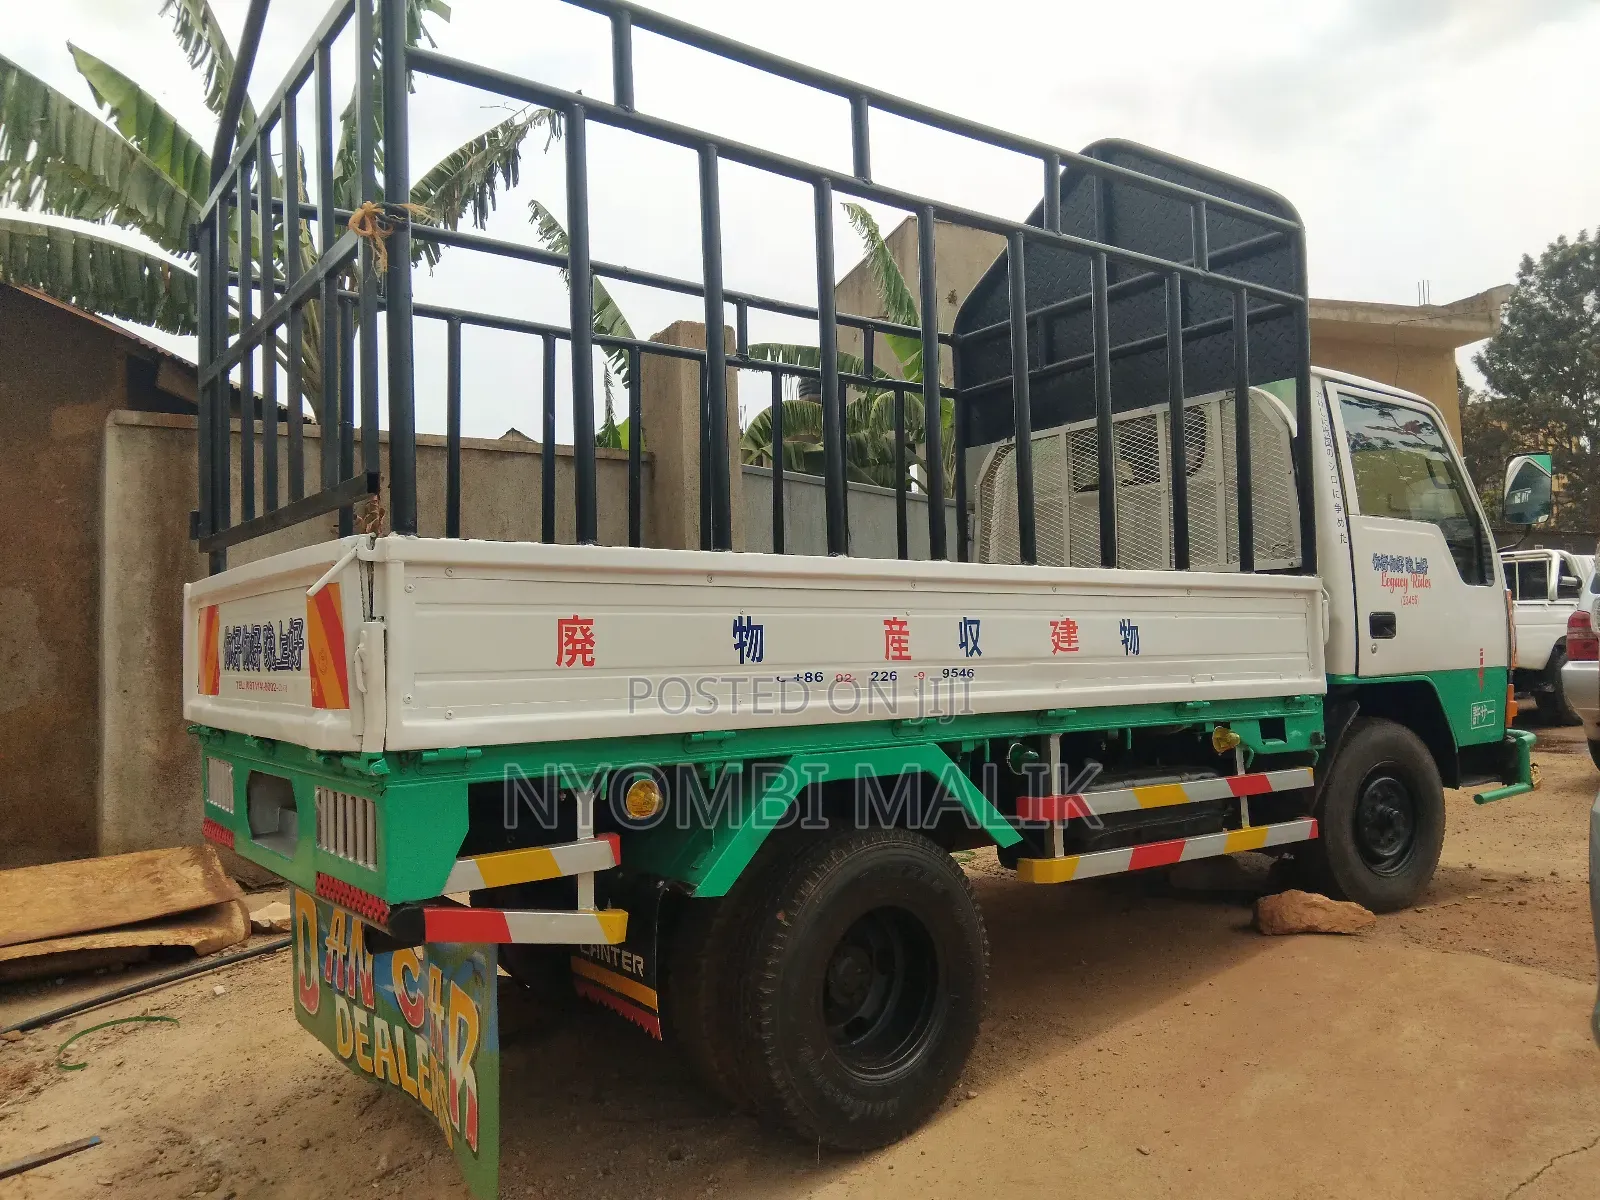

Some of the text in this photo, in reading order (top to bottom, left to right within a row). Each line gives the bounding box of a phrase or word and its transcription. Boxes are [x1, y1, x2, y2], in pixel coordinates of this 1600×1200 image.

[1381, 571, 1431, 594] Legacy Rides
[555, 614, 1141, 668] 廃 物 産 収 建 物
[794, 671, 824, 683] +86
[870, 671, 898, 682] 226
[942, 668, 974, 679] 9546
[295, 888, 479, 1152] DAN CAR
